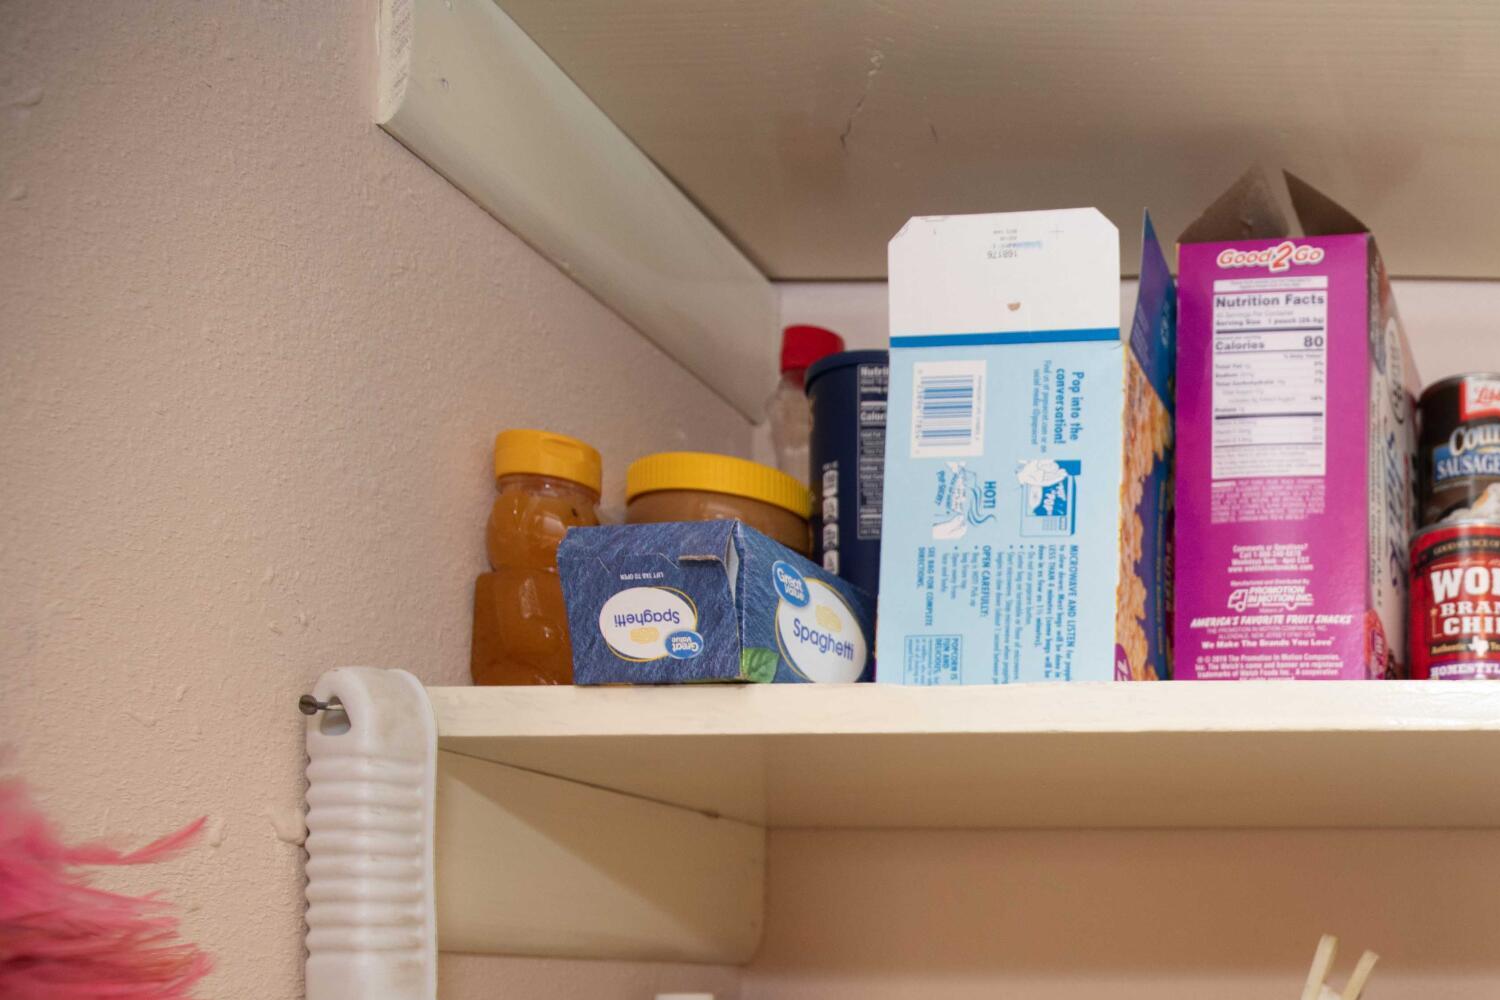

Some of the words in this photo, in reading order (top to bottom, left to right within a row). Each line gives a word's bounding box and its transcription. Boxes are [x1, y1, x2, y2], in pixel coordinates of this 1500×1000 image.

[1217, 241, 1324, 273] Good2Go
[1215, 295, 1280, 308] Nutrition
[1284, 293, 1325, 305] Facts
[1215, 340, 1265, 351] Calories
[1303, 335, 1324, 348] 80
[1071, 371, 1085, 393] Pop
[1053, 367, 1067, 445] conversation!
[1070, 396, 1082, 420] into
[1068, 422, 1081, 442] the
[983, 480, 997, 510] HOT!
[982, 545, 991, 568] OPEN
[1067, 544, 1079, 597] MICROWAVE
[614, 609, 680, 627] Spaghetti
[1190, 616, 1239, 628] AMERICA'S
[1240, 615, 1285, 626] FAVORITE
[1286, 614, 1315, 625] FRUIT
[1315, 614, 1353, 626] SNACKS
[793, 618, 855, 661] Spaghetti
